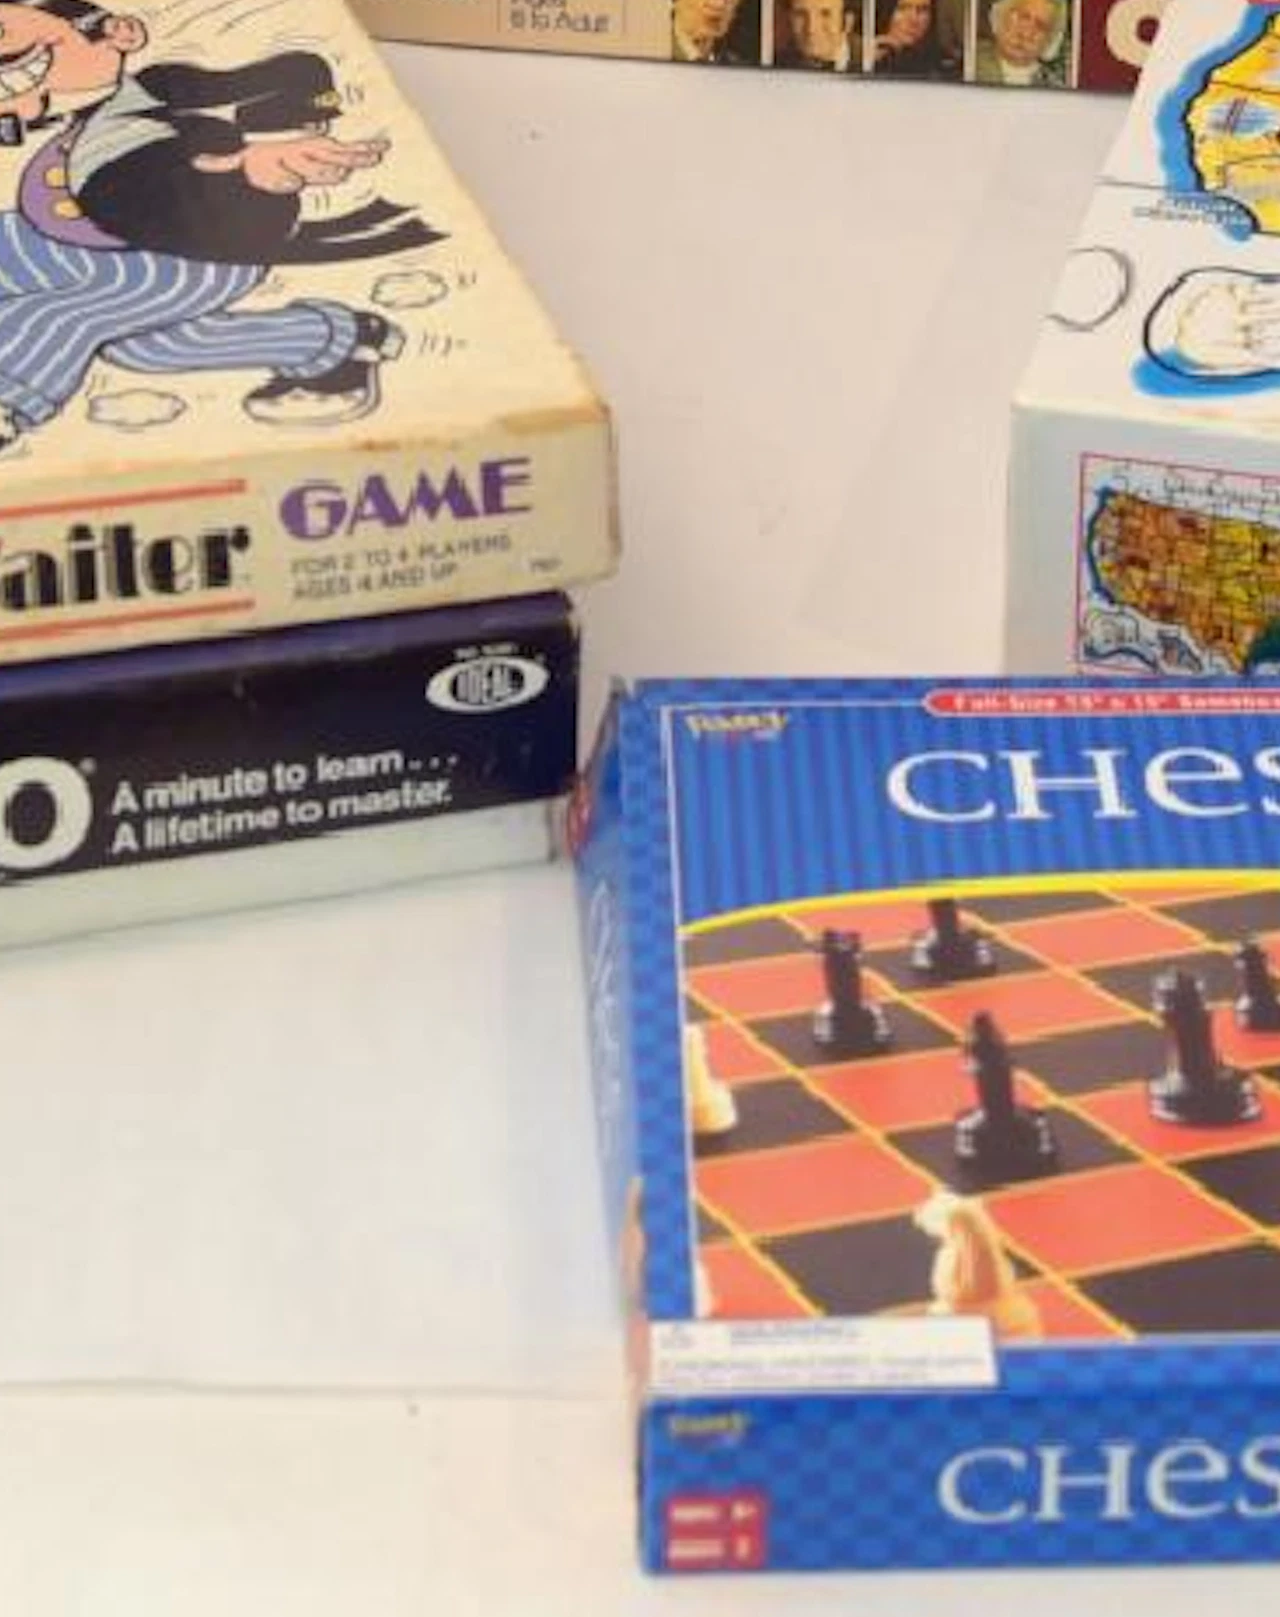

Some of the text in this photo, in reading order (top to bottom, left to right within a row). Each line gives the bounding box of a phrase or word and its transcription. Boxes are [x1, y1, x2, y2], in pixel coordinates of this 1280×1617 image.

[279, 456, 532, 543] GAME
[109, 777, 453, 855] A lifetime to master.
[111, 780, 139, 815] A
[143, 766, 270, 810] minute
[272, 760, 308, 794] to
